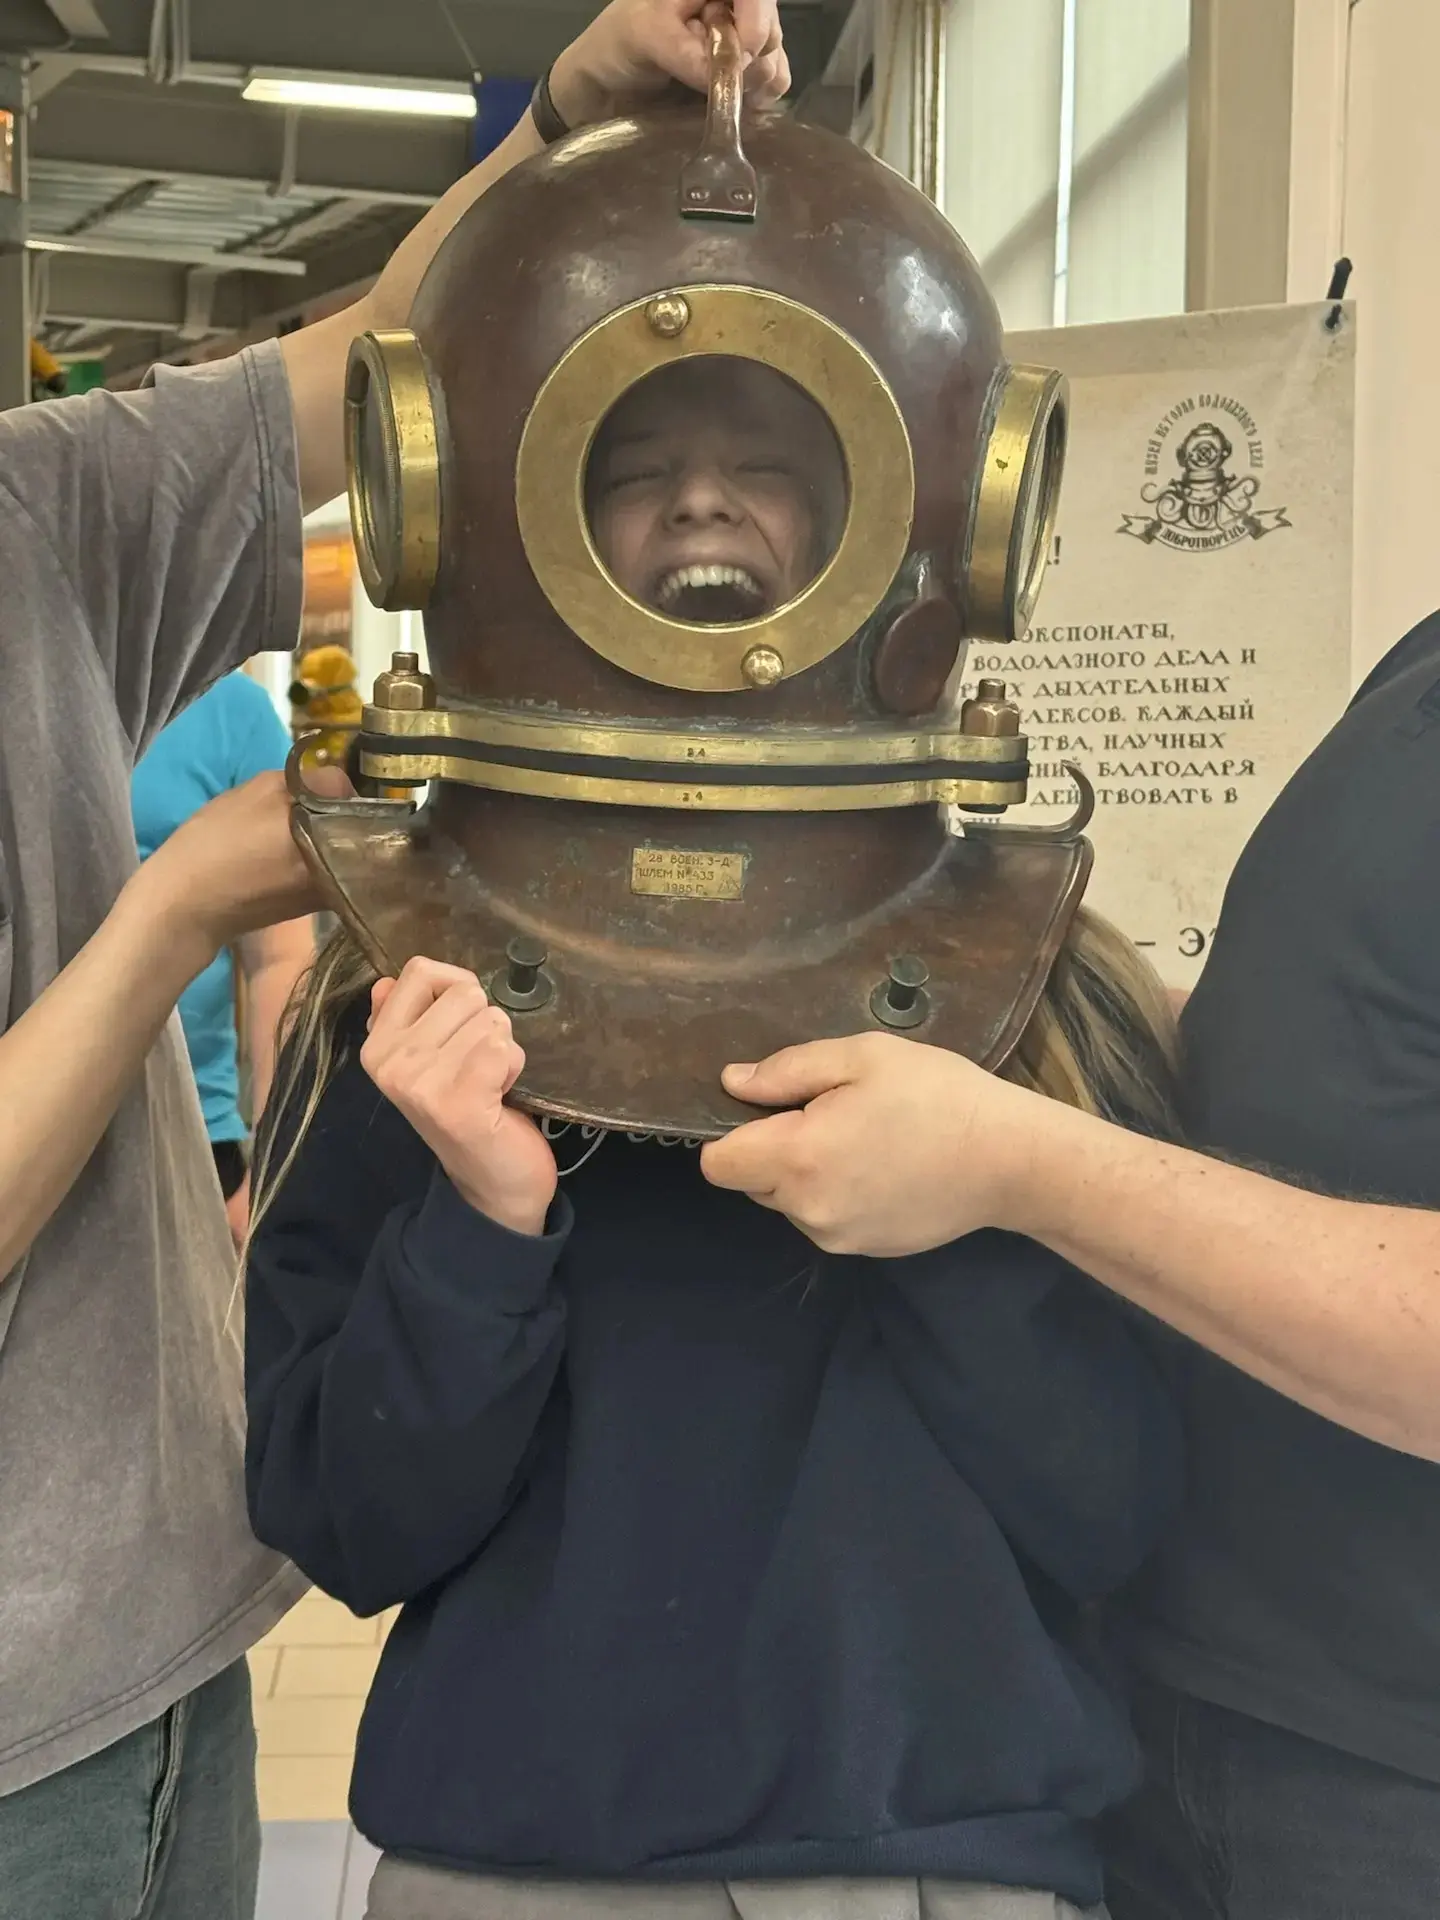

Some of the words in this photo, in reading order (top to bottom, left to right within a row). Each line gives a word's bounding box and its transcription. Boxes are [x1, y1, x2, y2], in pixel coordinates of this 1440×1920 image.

[1023, 622, 1176, 643] ЭКСПОНАТЫ,
[972, 651, 1146, 673] ВОДОЛАЗНОГО
[1154, 648, 1230, 668] ДЕЛА
[1240, 646, 1256, 665] И
[1033, 677, 1229, 698] ДЫХАТЕЛЬНЫХ
[1136, 698, 1255, 723] КАЖДЫЙ
[1103, 732, 1227, 751] НАУЧНЫХ
[1097, 758, 1256, 778] БЛАГОДАРЯ
[1030, 783, 1212, 807] ДЕЙТВОВАТЬ
[1223, 787, 1239, 804] В
[648, 853, 663, 864] 28
[638, 867, 672, 879] ШЛЕМ
[1179, 927, 1216, 957] Э
